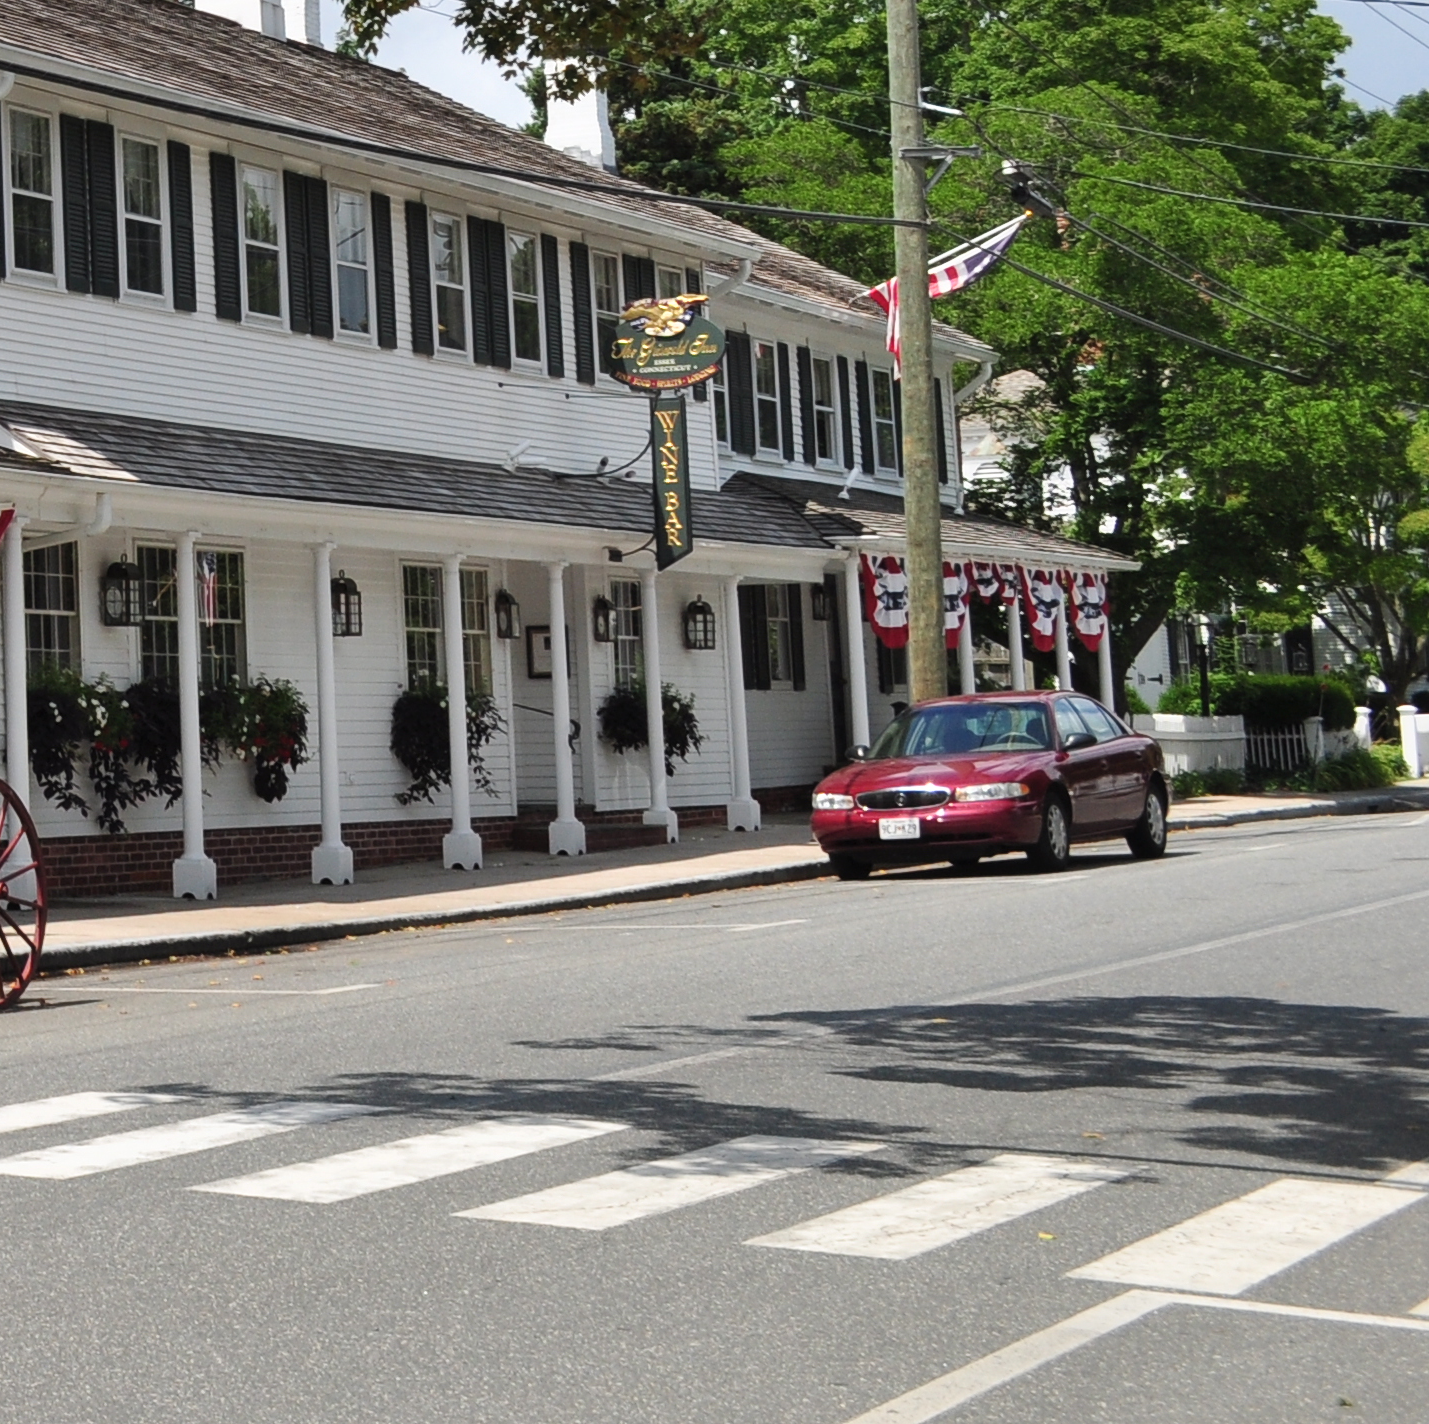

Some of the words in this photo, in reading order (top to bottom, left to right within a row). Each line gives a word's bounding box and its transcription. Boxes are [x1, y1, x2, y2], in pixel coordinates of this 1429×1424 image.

[611, 338, 638, 359] The
[636, 337, 689, 366] Griswold
[689, 334, 717, 355] Inn
[654, 410, 680, 483] WINE
[664, 491, 683, 546] BAR
